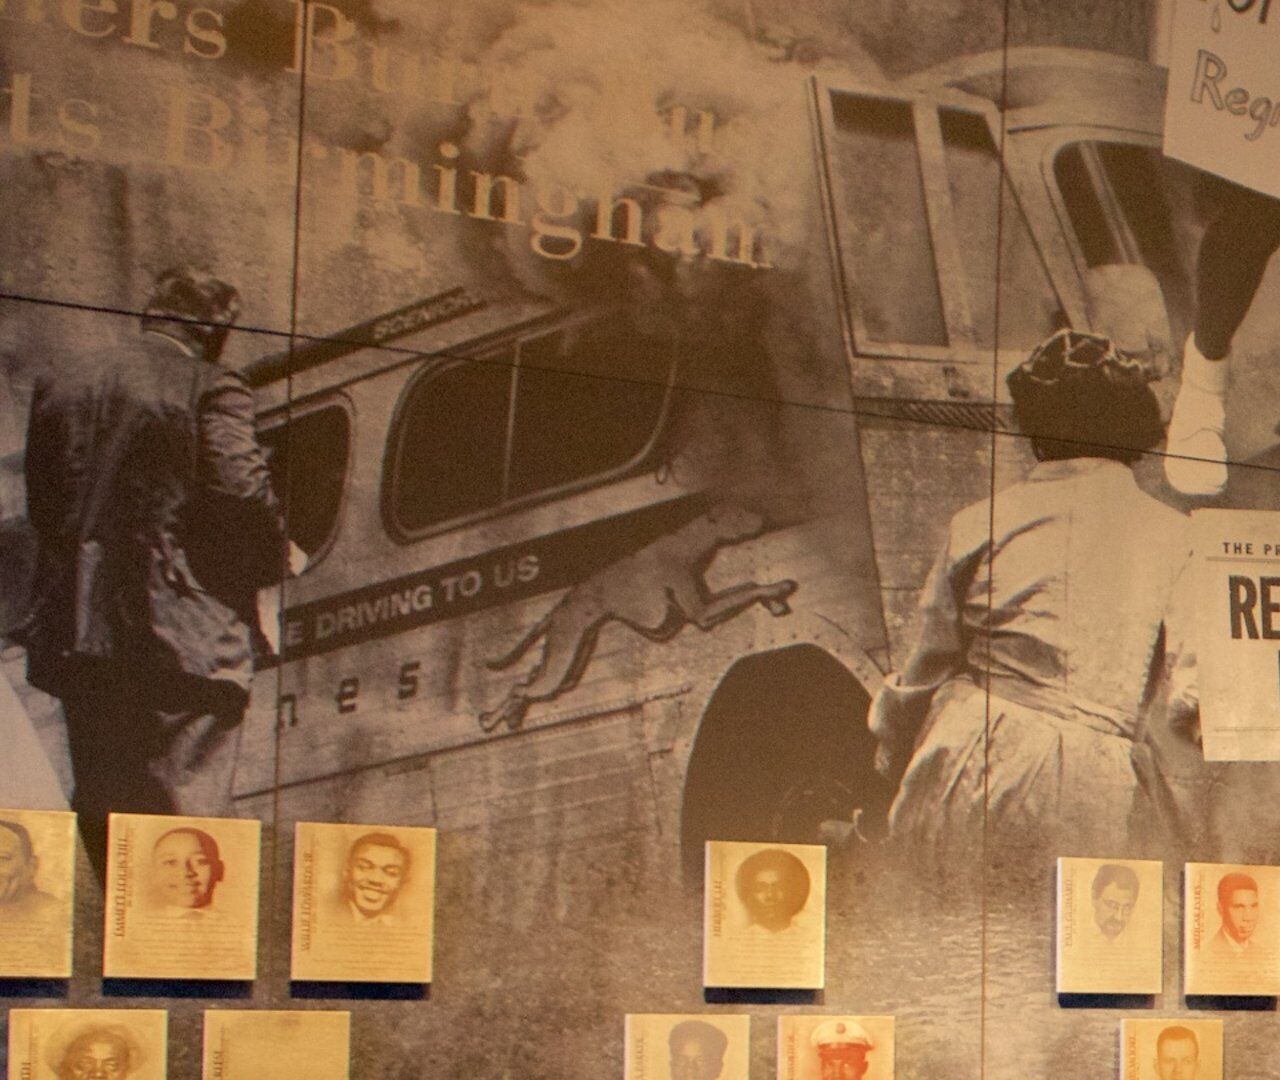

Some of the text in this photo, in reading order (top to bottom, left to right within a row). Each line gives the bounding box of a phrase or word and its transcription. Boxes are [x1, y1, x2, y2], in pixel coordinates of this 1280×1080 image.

[1223, 542, 1253, 555] THE
[316, 584, 435, 640] DRIVING
[440, 569, 483, 602] TO
[494, 554, 541, 589] US
